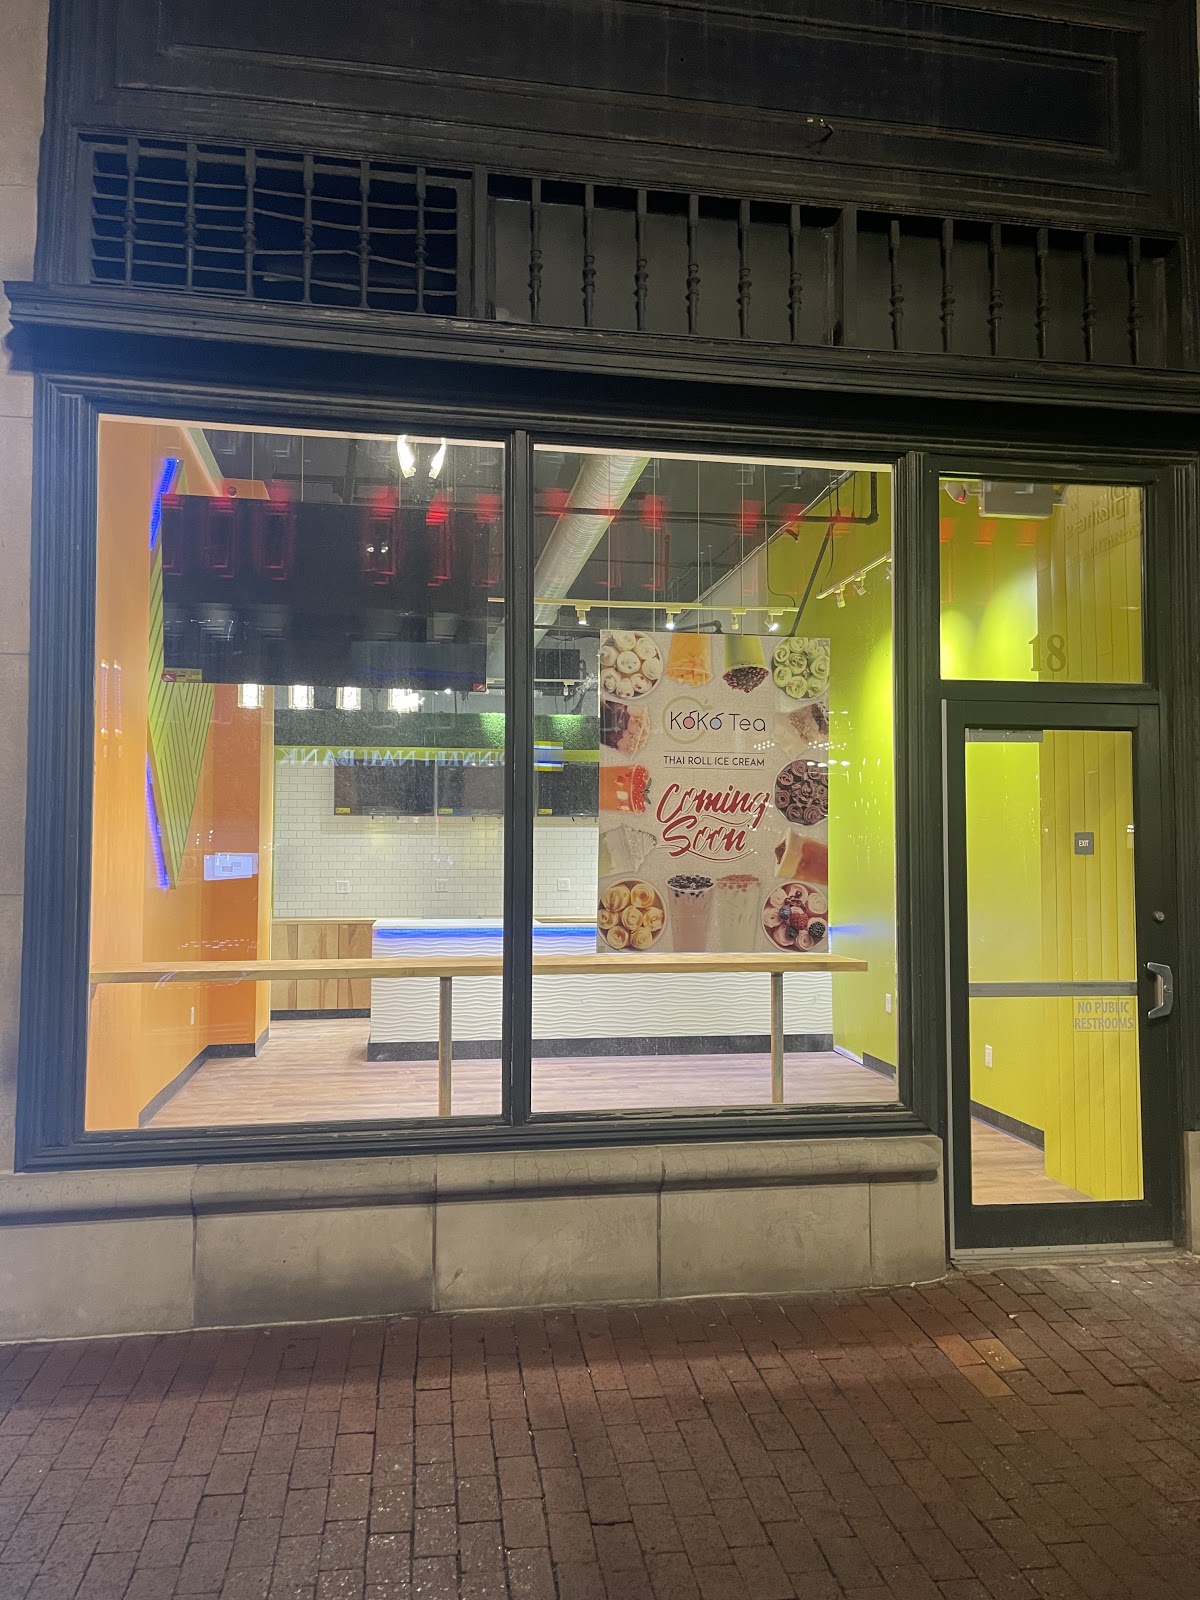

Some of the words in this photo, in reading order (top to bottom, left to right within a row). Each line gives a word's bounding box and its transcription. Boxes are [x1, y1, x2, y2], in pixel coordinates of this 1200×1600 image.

[1029, 634, 1066, 673] 18
[729, 713, 766, 732] Tea
[663, 755, 685, 765] THAI
[688, 756, 711, 765] ROLL
[714, 757, 729, 766] ICE
[732, 757, 765, 767] CREAM
[656, 783, 770, 829] Coming
[662, 815, 746, 857] Soon
[1078, 839, 1090, 847] EXIT
[1077, 1001, 1092, 1013] NO
[1095, 1001, 1129, 1014] PUBLIC
[1074, 1017, 1134, 1030] RESTROOMS
